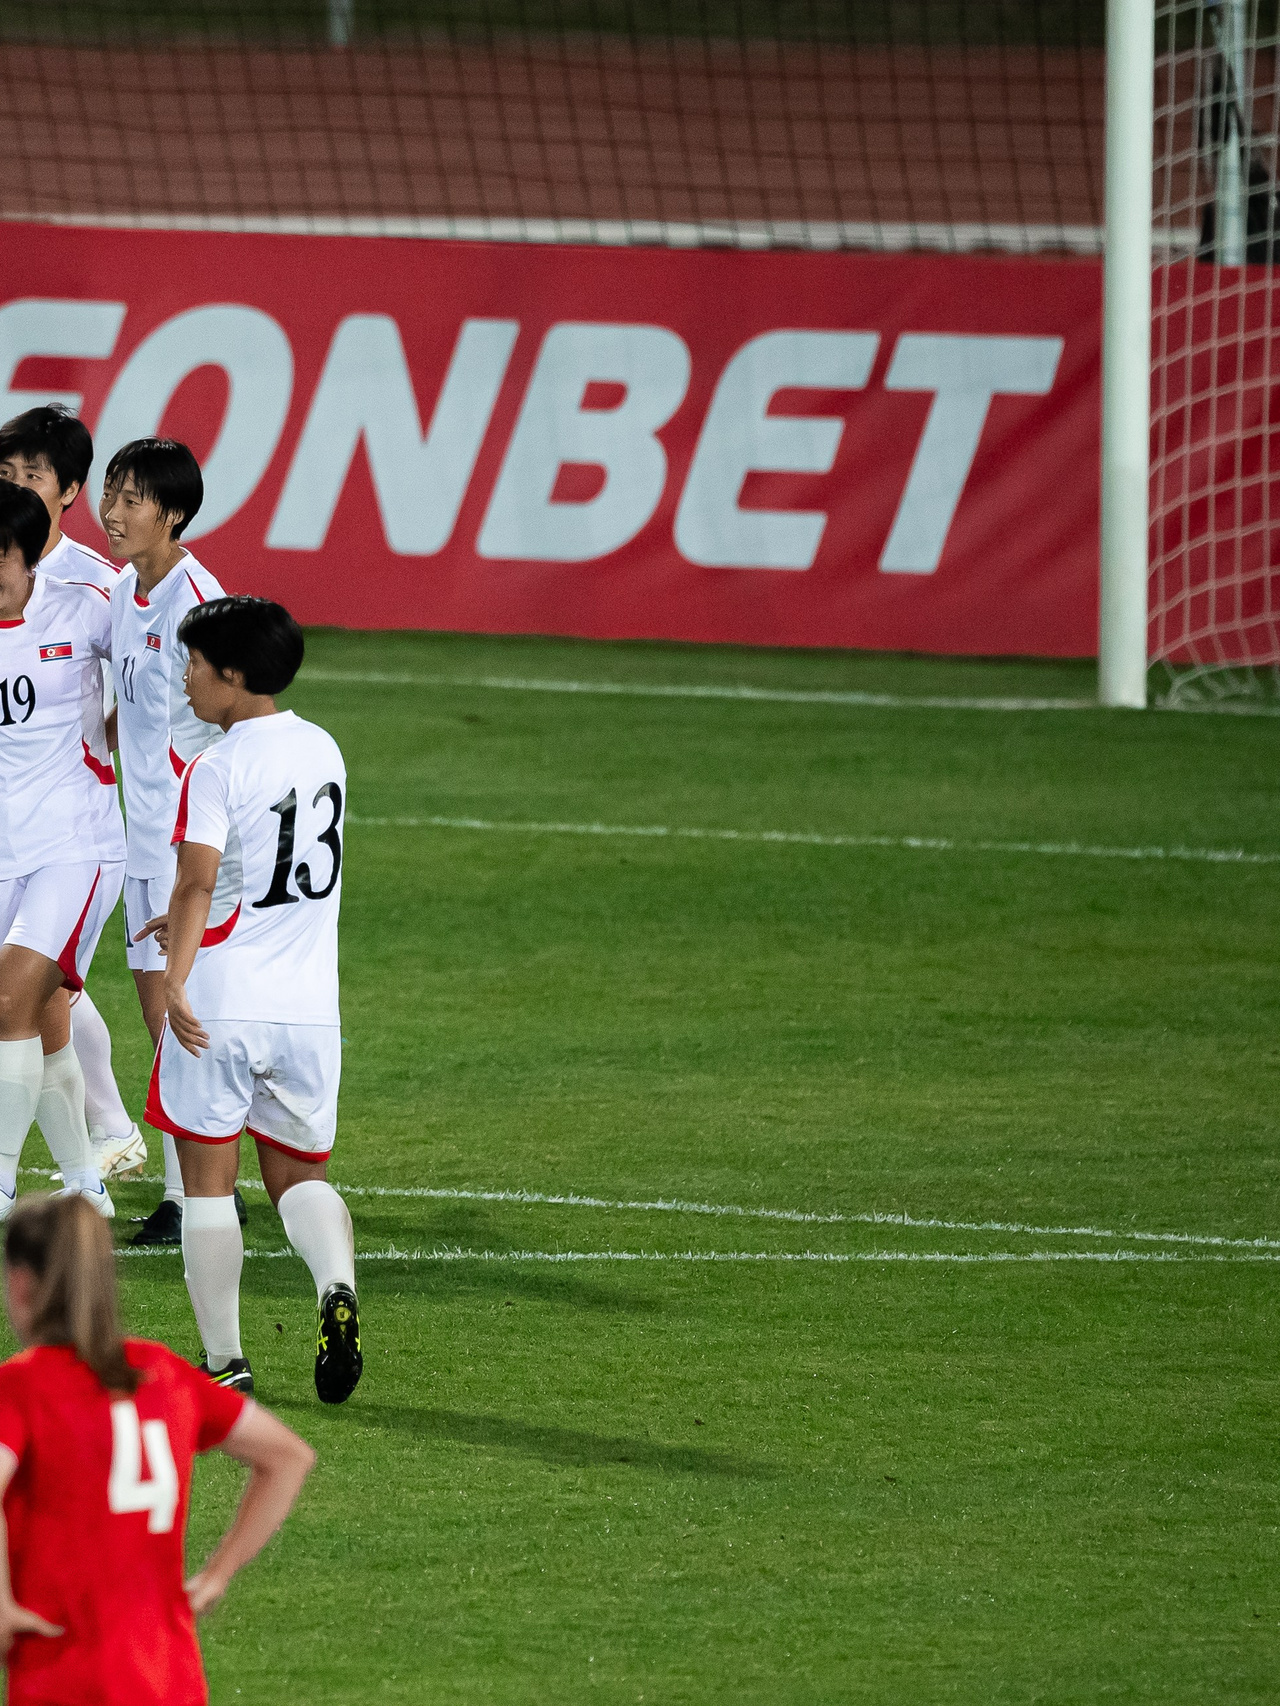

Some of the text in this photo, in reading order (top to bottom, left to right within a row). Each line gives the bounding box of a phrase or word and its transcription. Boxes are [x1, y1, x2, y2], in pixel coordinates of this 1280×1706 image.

[122, 654, 136, 705] 11
[251, 781, 343, 909] 13
[108, 1399, 180, 1534] 4
